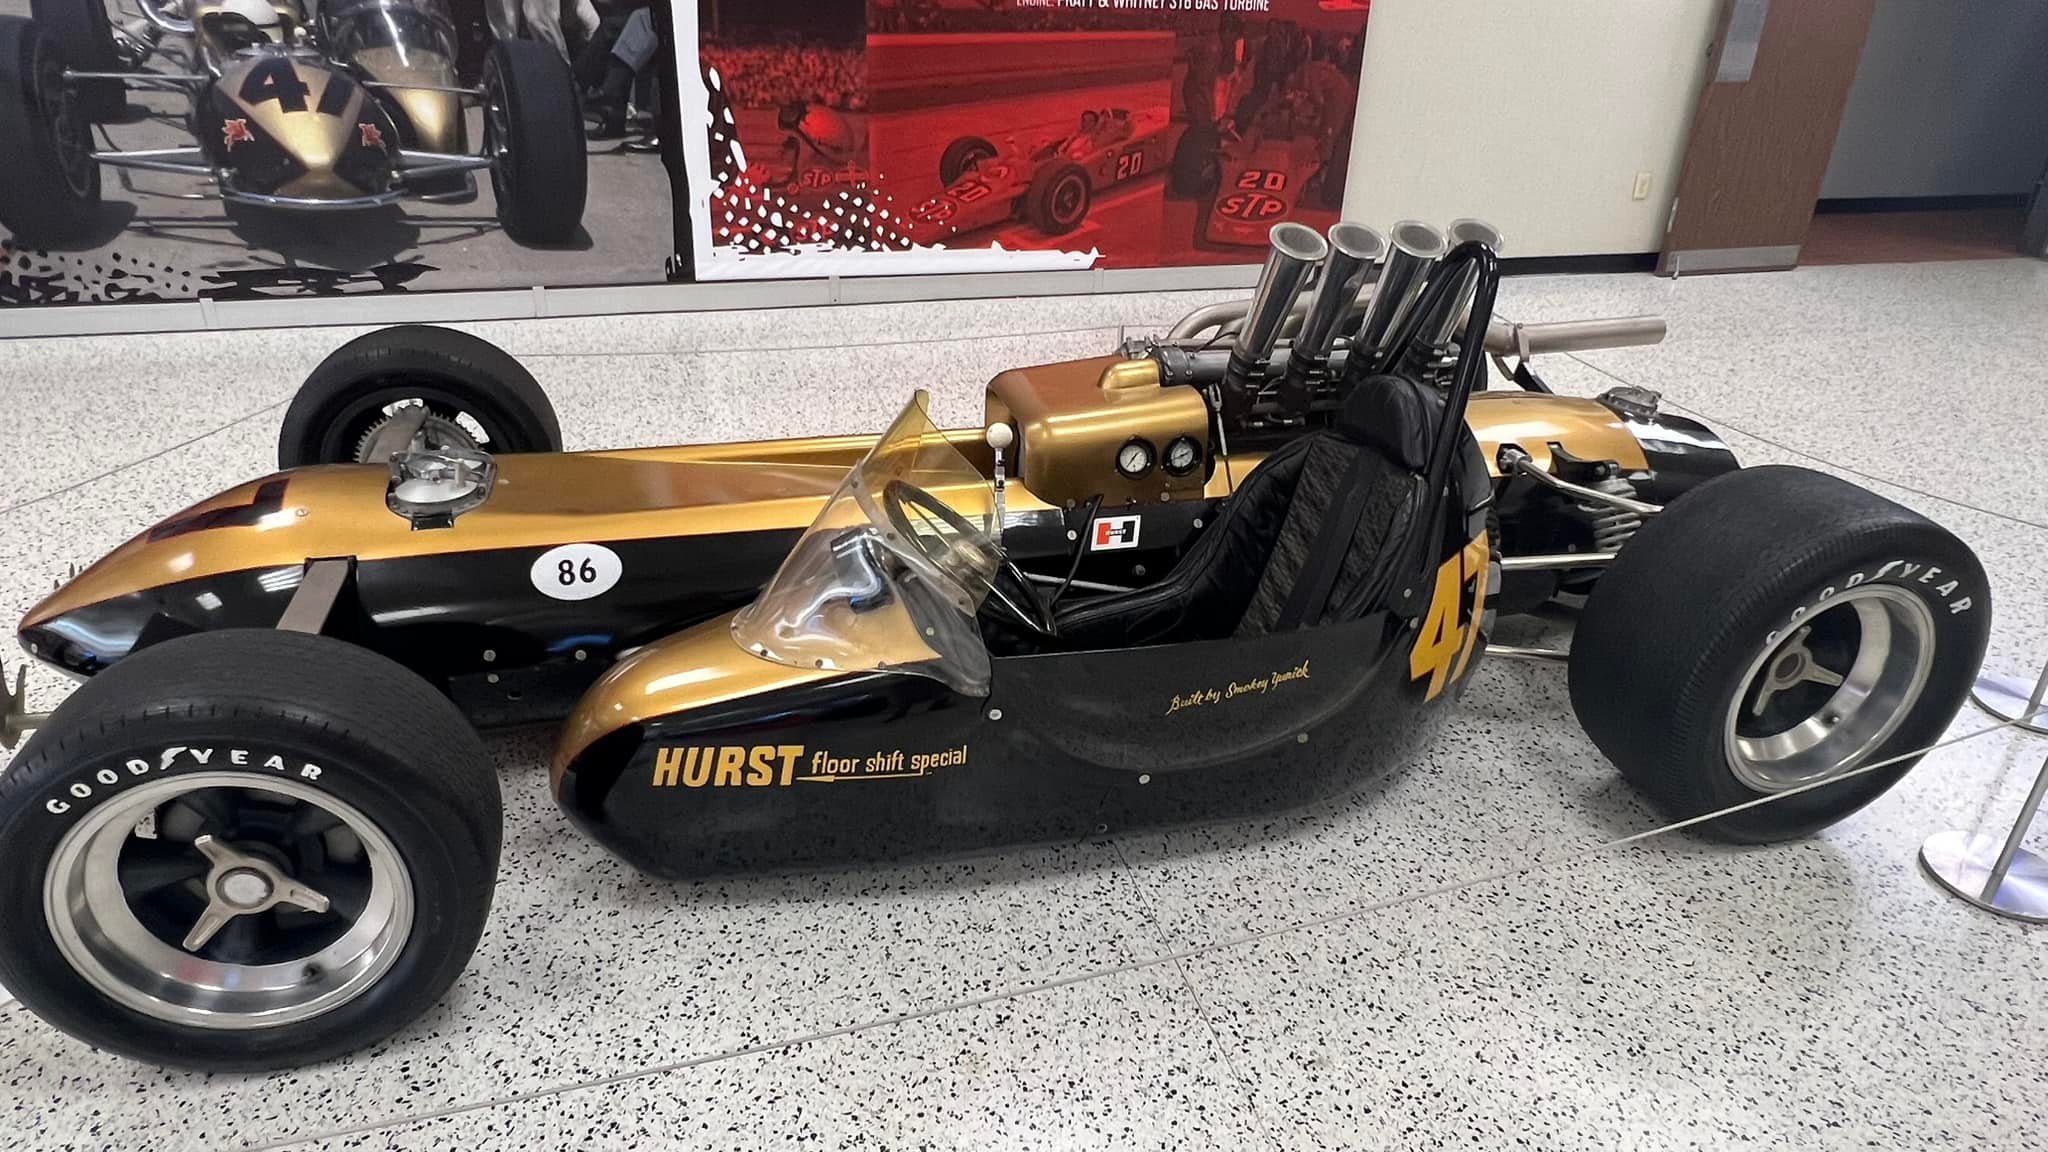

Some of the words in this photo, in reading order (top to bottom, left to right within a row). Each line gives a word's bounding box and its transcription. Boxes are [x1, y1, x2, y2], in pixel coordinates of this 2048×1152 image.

[1097, 0, 1110, 8] &
[1195, 0, 1219, 11] GAS
[1222, 0, 1270, 12] TURBINE
[803, 168, 832, 192] STP
[1116, 151, 1143, 181] 20
[1238, 170, 1287, 191] 20
[1220, 193, 1283, 219] STP
[558, 556, 597, 586] 86
[1410, 529, 1490, 704] 47
[1164, 690, 1204, 717] Built
[1204, 687, 1222, 704] by
[1224, 678, 1270, 699] Smokey
[1270, 659, 1312, 691] Yunick
[46, 746, 323, 814] GOODYEAR
[652, 745, 805, 788] HURST
[811, 751, 861, 775] floor
[865, 751, 905, 773] shift
[910, 745, 968, 776] special
